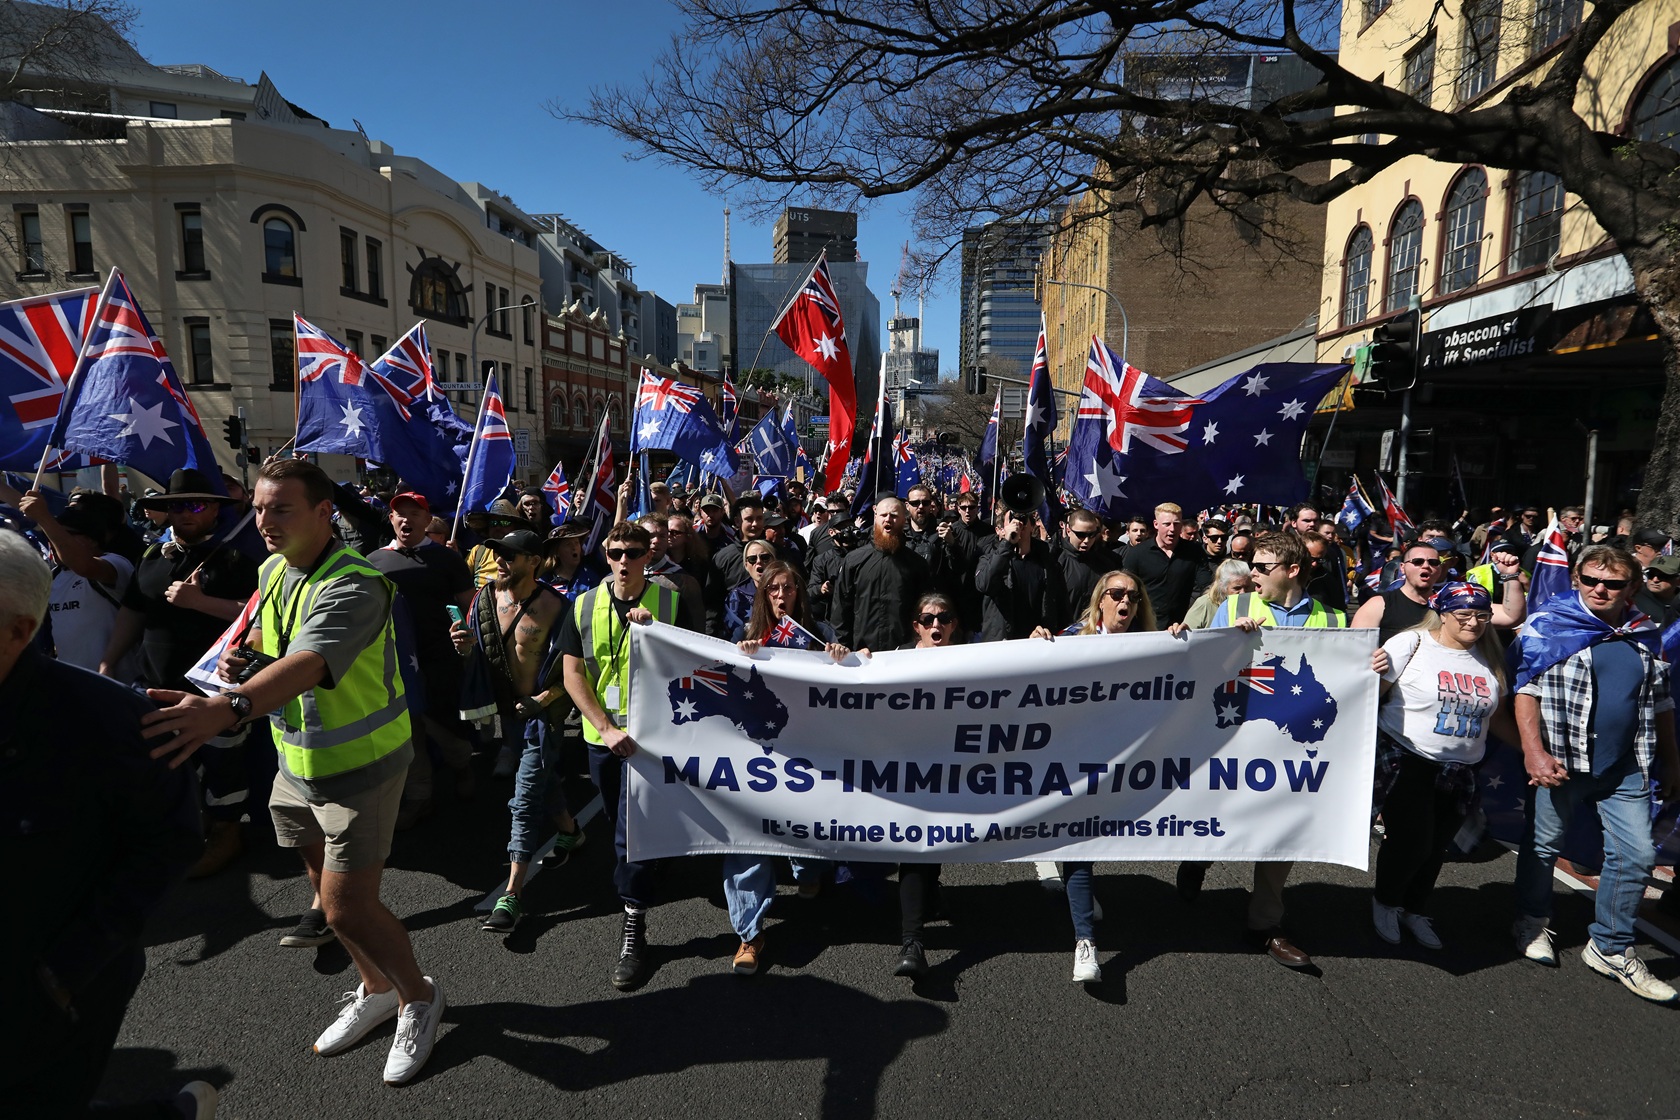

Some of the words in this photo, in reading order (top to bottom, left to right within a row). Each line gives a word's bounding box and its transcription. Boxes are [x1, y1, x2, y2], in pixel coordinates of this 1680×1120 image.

[789, 212, 809, 221] UTS
[1438, 316, 1518, 348] obacconist
[1435, 350, 1459, 367] ift
[1462, 336, 1535, 366] Specialist
[62, 601, 80, 610] AIR
[808, 686, 936, 710] March
[943, 687, 1012, 710] For
[1017, 673, 1196, 708] Australia
[1437, 670, 1492, 698] AUS
[1438, 691, 1493, 718] TRA
[954, 722, 1052, 753] END
[1433, 712, 1482, 739] LIA
[661, 755, 1191, 796] MASS-IMMIGRATION
[1209, 757, 1330, 793] NOW
[762, 818, 809, 839] It's
[814, 819, 884, 843] time
[889, 822, 921, 843] to
[927, 822, 980, 847] put
[982, 815, 1153, 842] Australians
[1156, 814, 1226, 837] first
